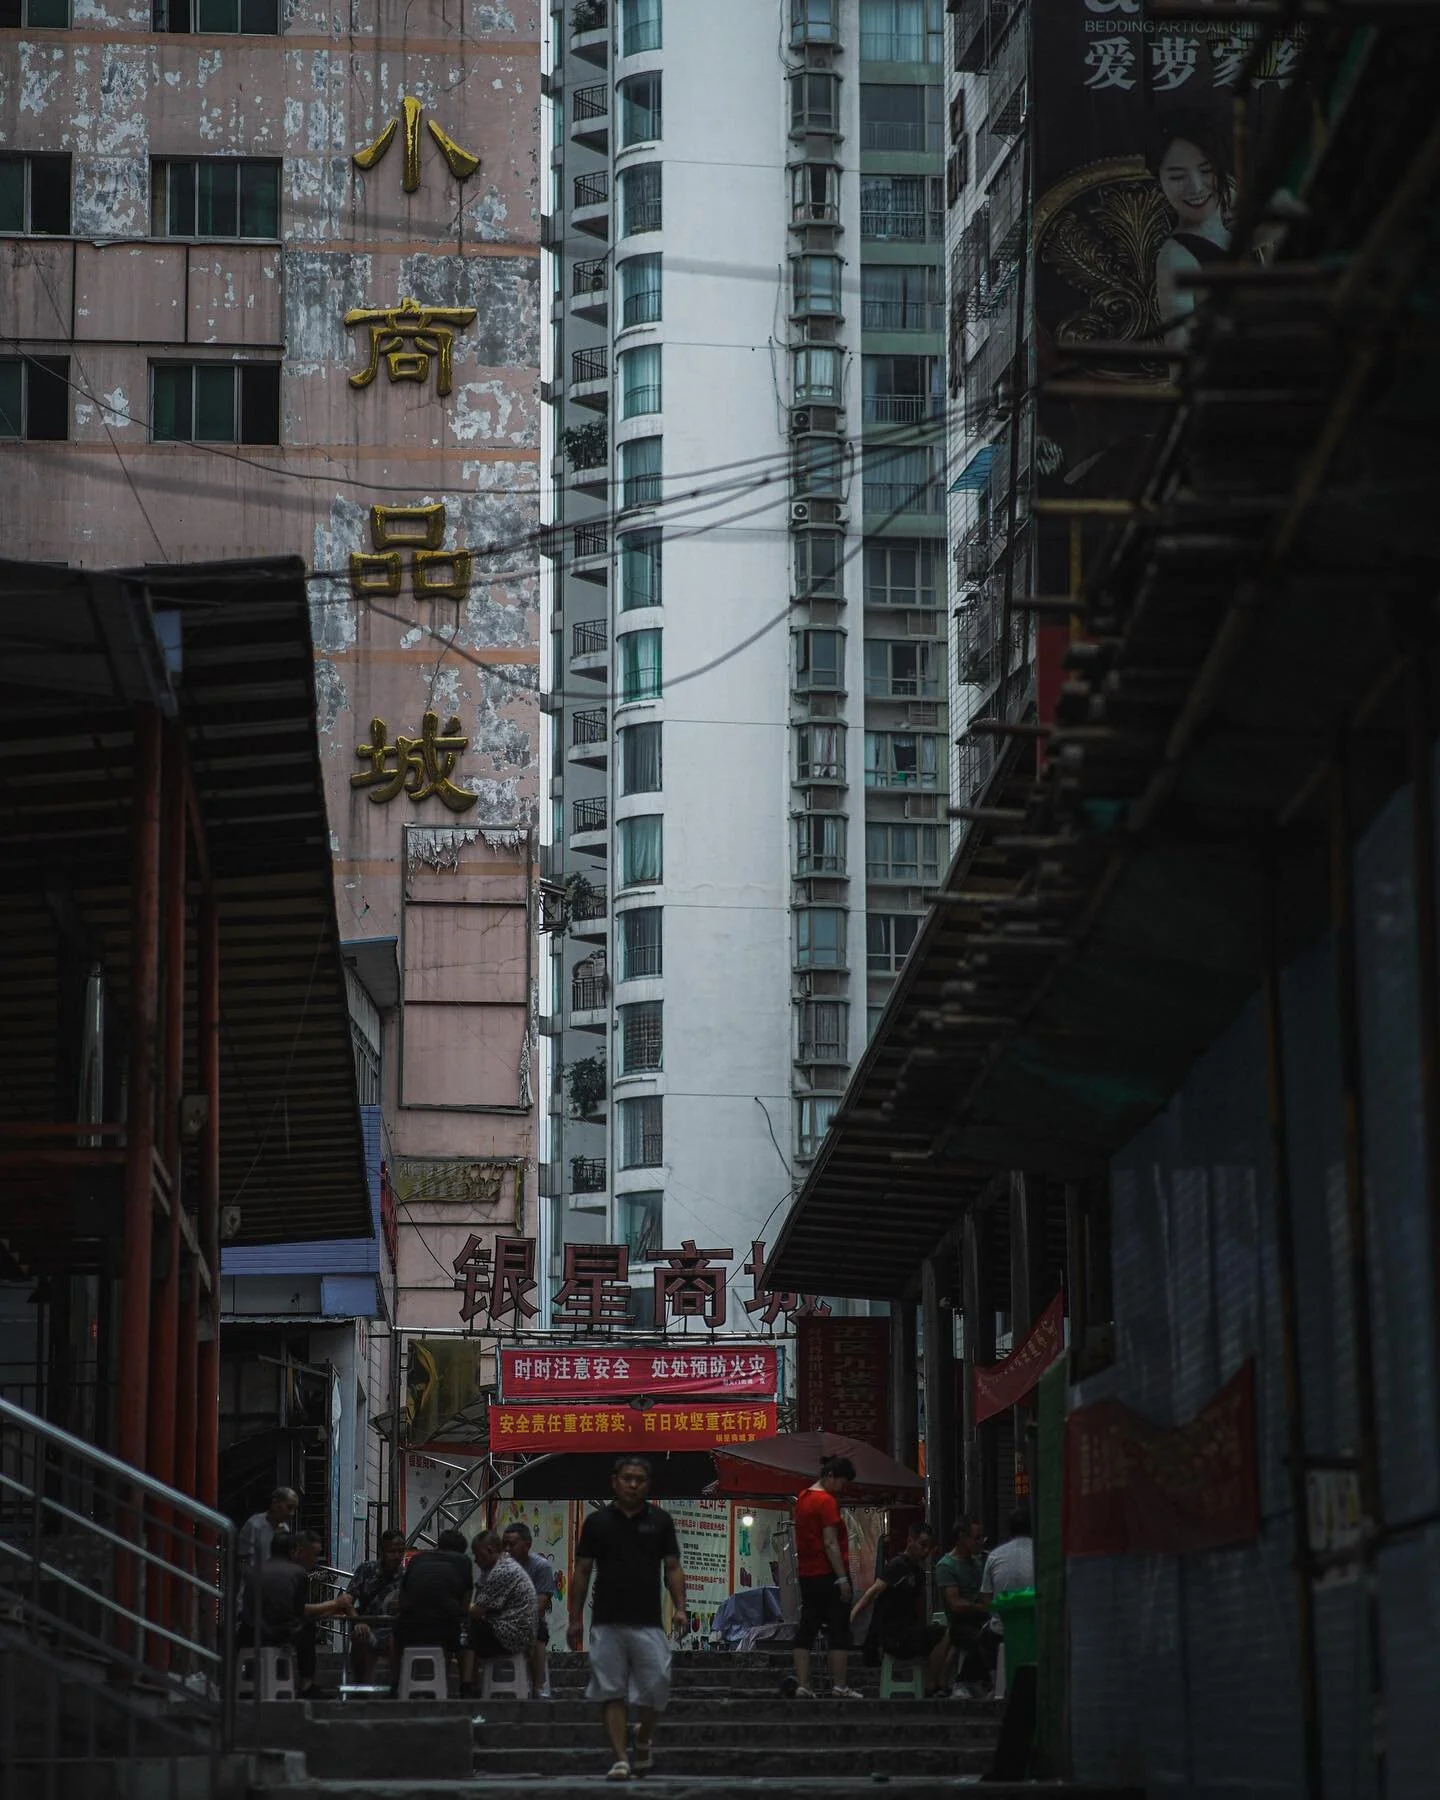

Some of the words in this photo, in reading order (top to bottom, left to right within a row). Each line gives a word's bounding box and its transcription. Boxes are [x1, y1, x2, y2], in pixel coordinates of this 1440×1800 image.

[1084, 19, 1155, 33] BEDDING
[514, 1356, 631, 1380] 时时注意安全
[651, 1353, 766, 1380] 处处预防火灾
